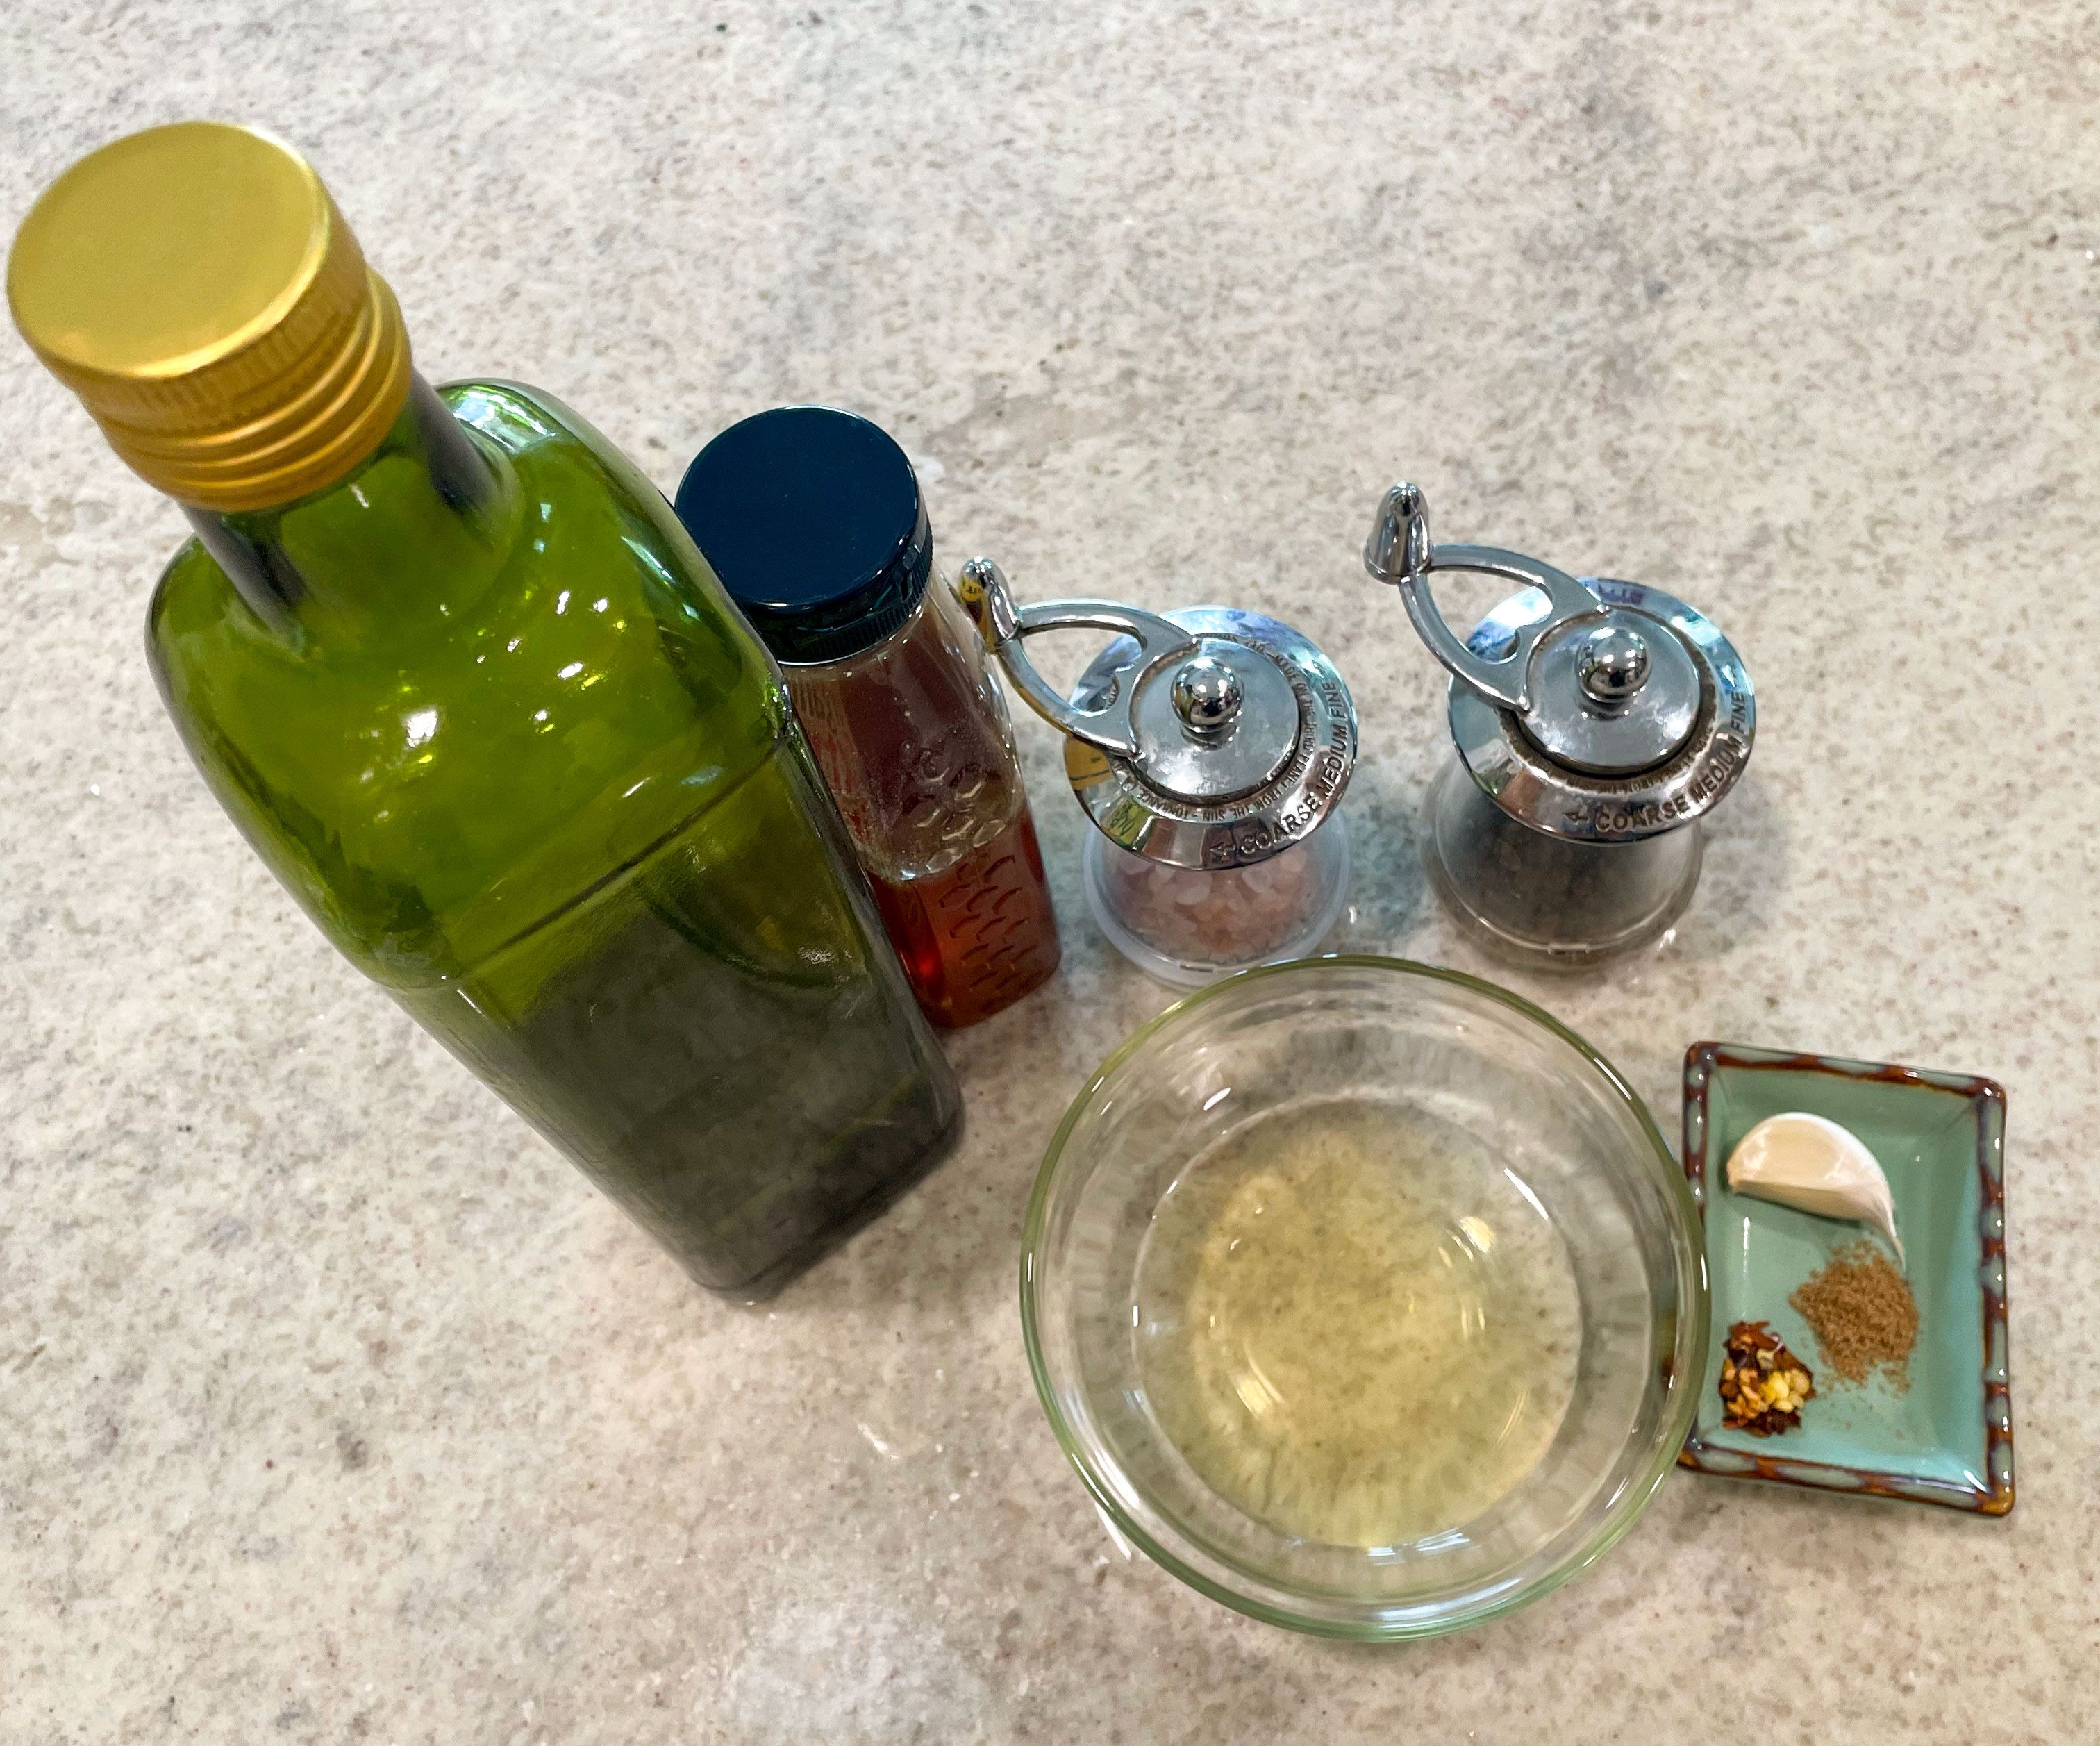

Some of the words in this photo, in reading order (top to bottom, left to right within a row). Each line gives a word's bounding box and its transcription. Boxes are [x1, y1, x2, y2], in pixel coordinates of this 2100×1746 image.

[1322, 680, 1347, 718] FINE
[1281, 754, 1310, 789] PLANET
[1316, 724, 1348, 800] MEDIUM
[1595, 794, 1690, 832] COARSE
[1688, 734, 1744, 805] MEDIUM
[1731, 692, 1747, 734] FINE
[1203, 808, 1225, 822] SUN
[1230, 804, 1251, 817] THE
[1255, 787, 1283, 808] FROM
[1241, 793, 1322, 854] COARSE
